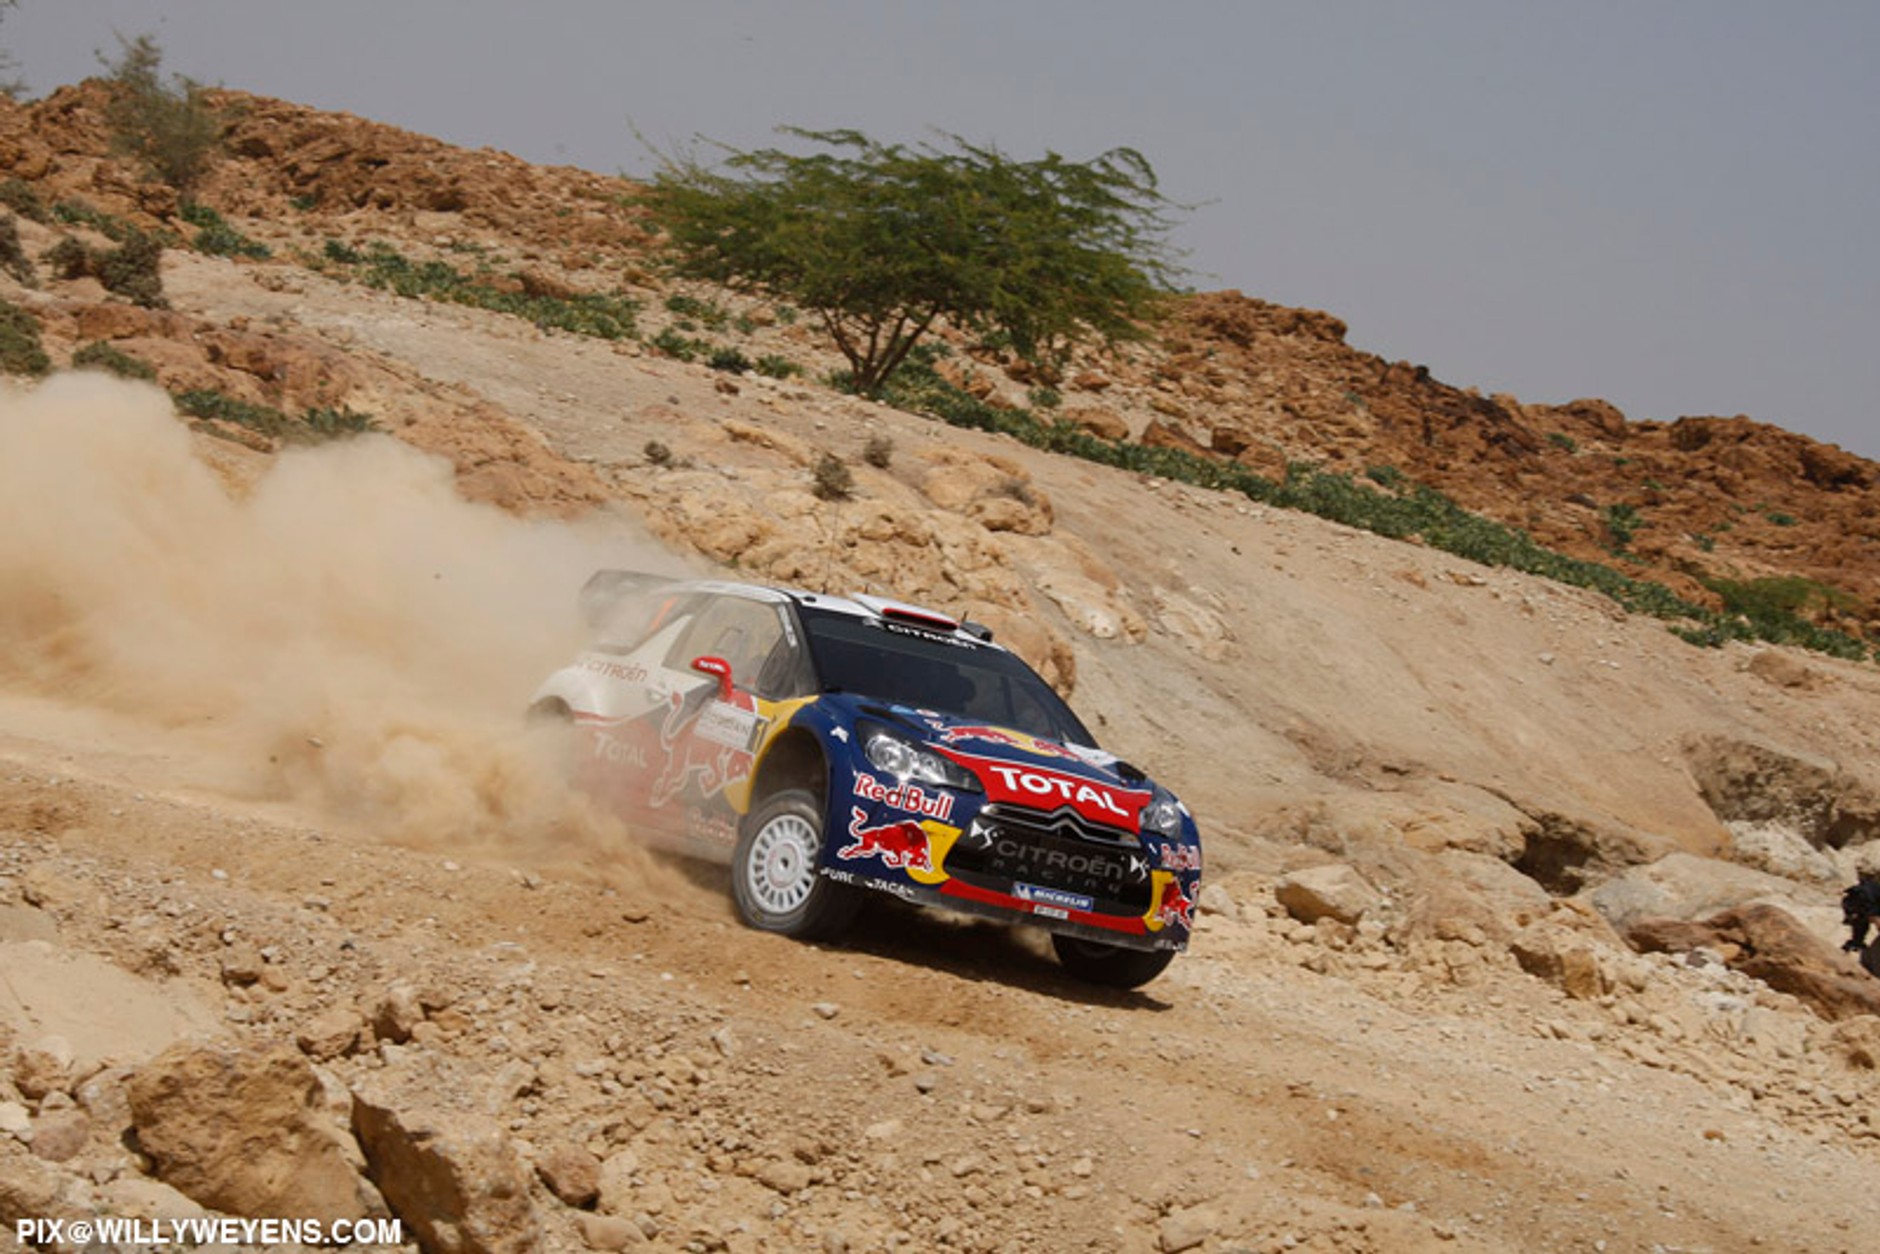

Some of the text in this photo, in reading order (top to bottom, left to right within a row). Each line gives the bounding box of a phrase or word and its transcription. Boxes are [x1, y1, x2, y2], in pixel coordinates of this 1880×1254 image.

[853, 773, 956, 821] Red Bull
[990, 765, 1130, 818] TOTAL
